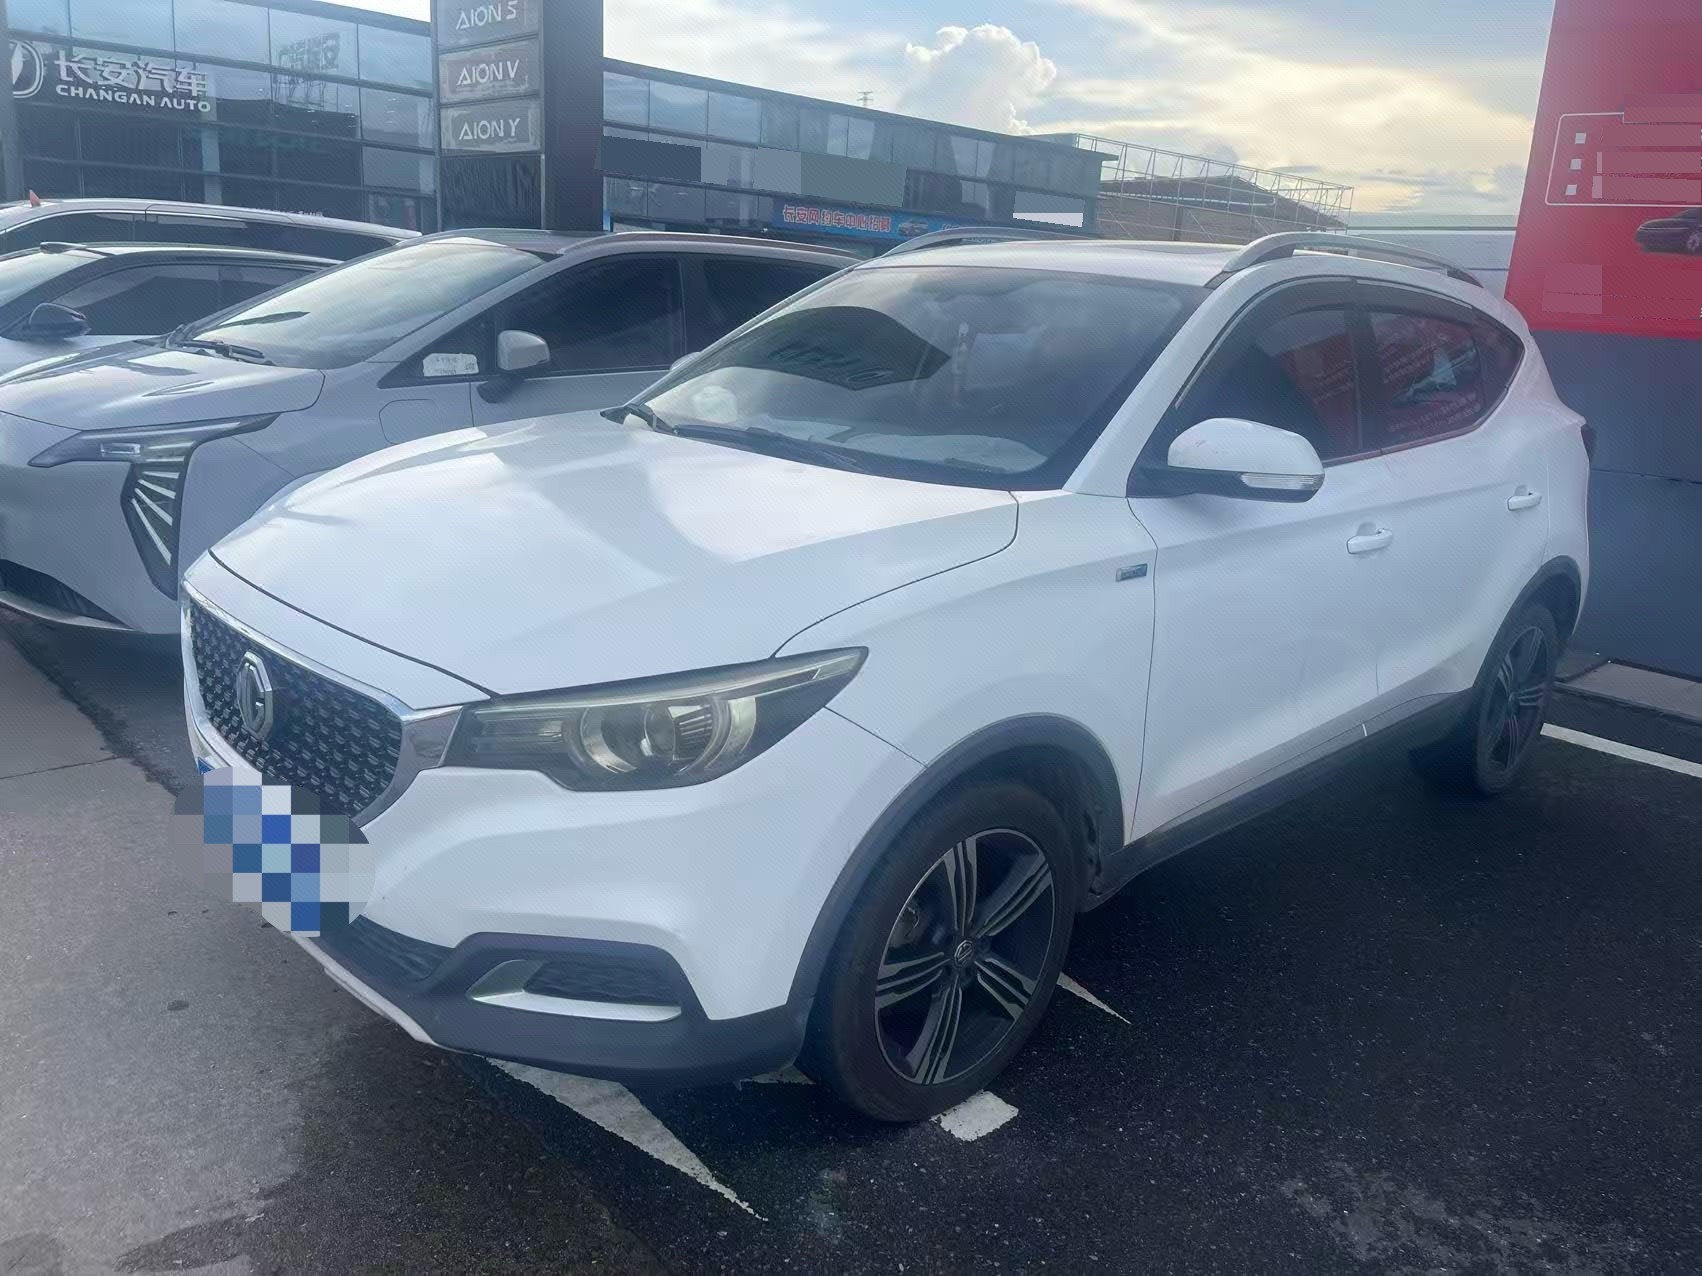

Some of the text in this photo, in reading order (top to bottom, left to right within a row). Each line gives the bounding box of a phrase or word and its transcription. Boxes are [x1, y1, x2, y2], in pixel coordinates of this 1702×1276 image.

[456, 0, 519, 30] AION S
[54, 49, 209, 97] 长安汽车
[456, 59, 520, 86] AION V
[55, 84, 211, 113] CHANGAN AUTO
[459, 117, 521, 140] AION Y
